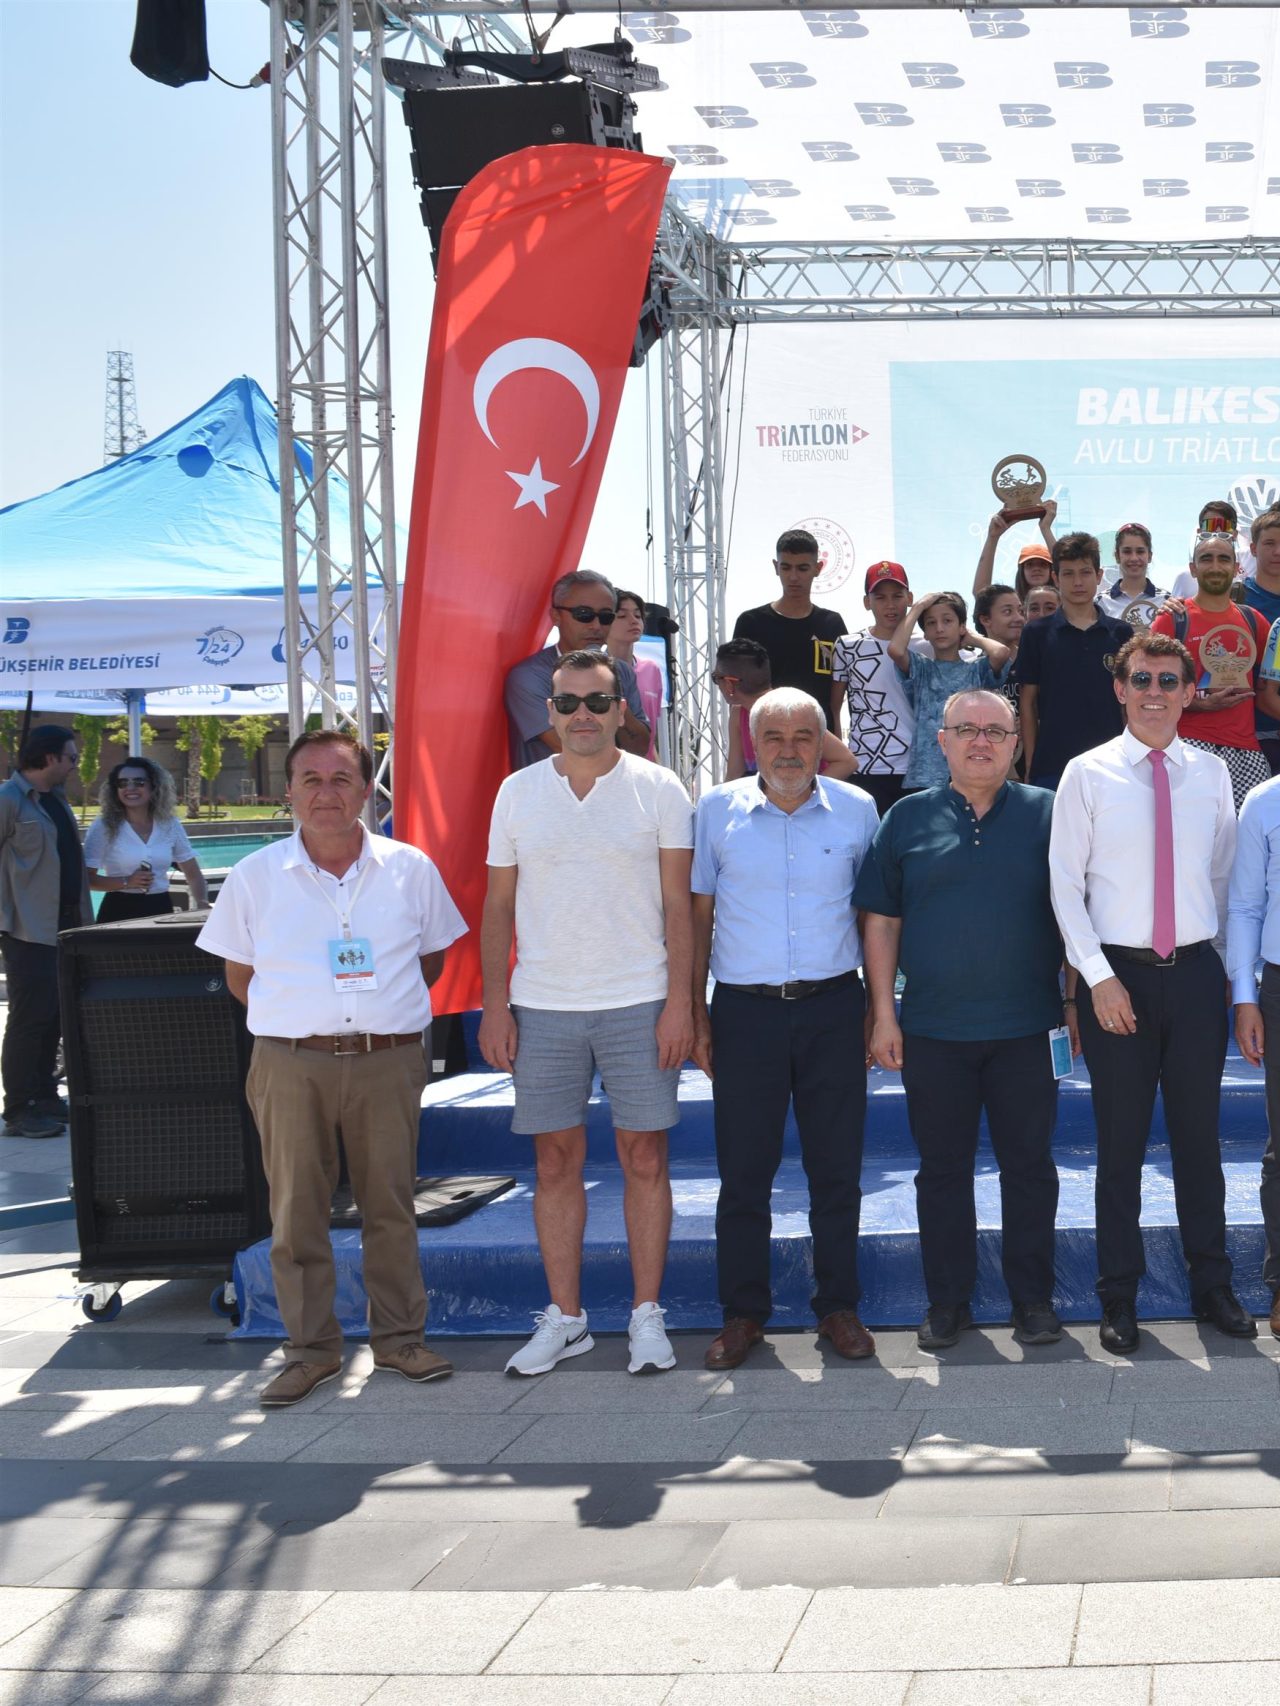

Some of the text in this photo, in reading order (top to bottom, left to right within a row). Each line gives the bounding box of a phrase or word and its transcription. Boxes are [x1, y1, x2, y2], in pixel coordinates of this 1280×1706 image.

[809, 406, 848, 421] TÜRKİYE
[782, 449, 849, 462] FEDERASYONU
[1073, 438, 1154, 464] AVLU
[68, 653, 161, 671] BELEDİYESİ
